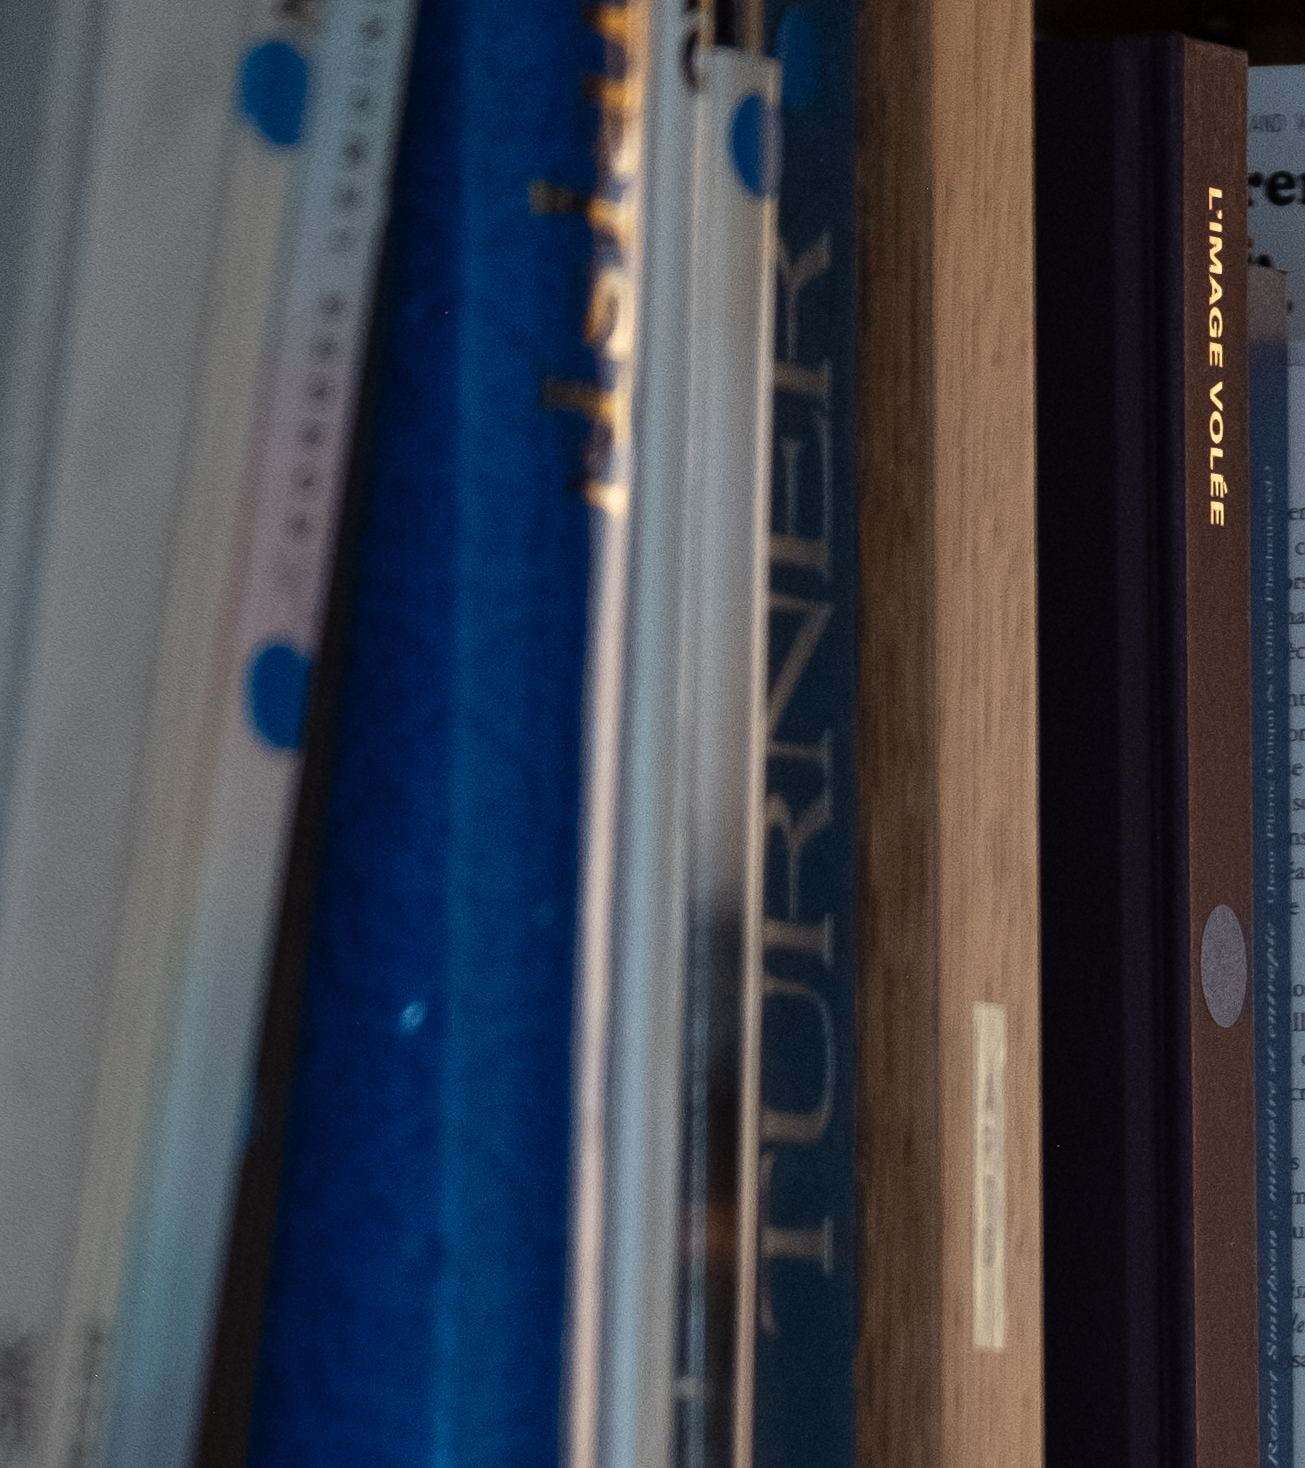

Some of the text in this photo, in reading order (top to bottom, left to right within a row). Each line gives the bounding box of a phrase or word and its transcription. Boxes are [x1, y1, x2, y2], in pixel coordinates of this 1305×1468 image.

[1206, 186, 1226, 528] L'IMAGE VOLÉE
[1264, 1229, 1278, 1361] Smithson
[1265, 1370, 1279, 1466] Robert
